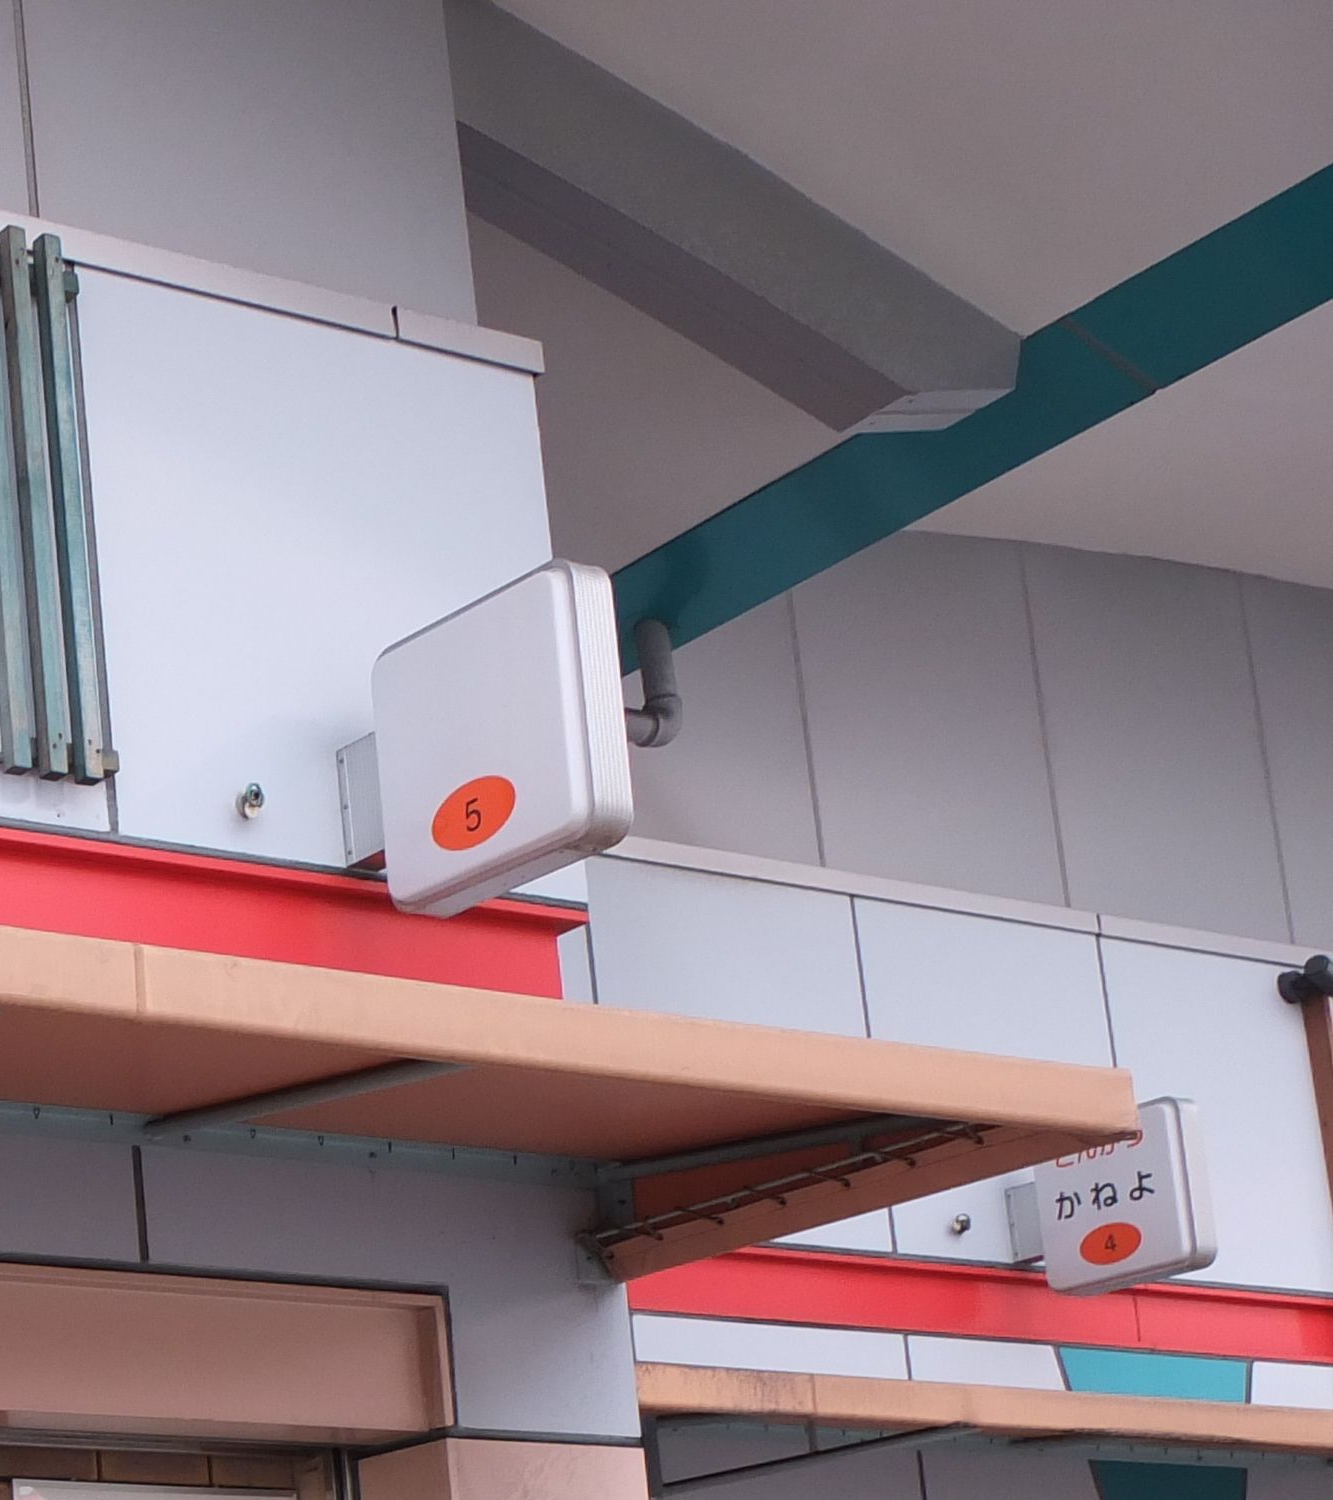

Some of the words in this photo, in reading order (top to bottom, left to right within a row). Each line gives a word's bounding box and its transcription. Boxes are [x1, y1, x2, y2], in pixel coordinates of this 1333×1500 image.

[464, 797, 482, 832] 5
[1054, 1170, 1156, 1221] かねよ
[1104, 1234, 1118, 1252] 4
